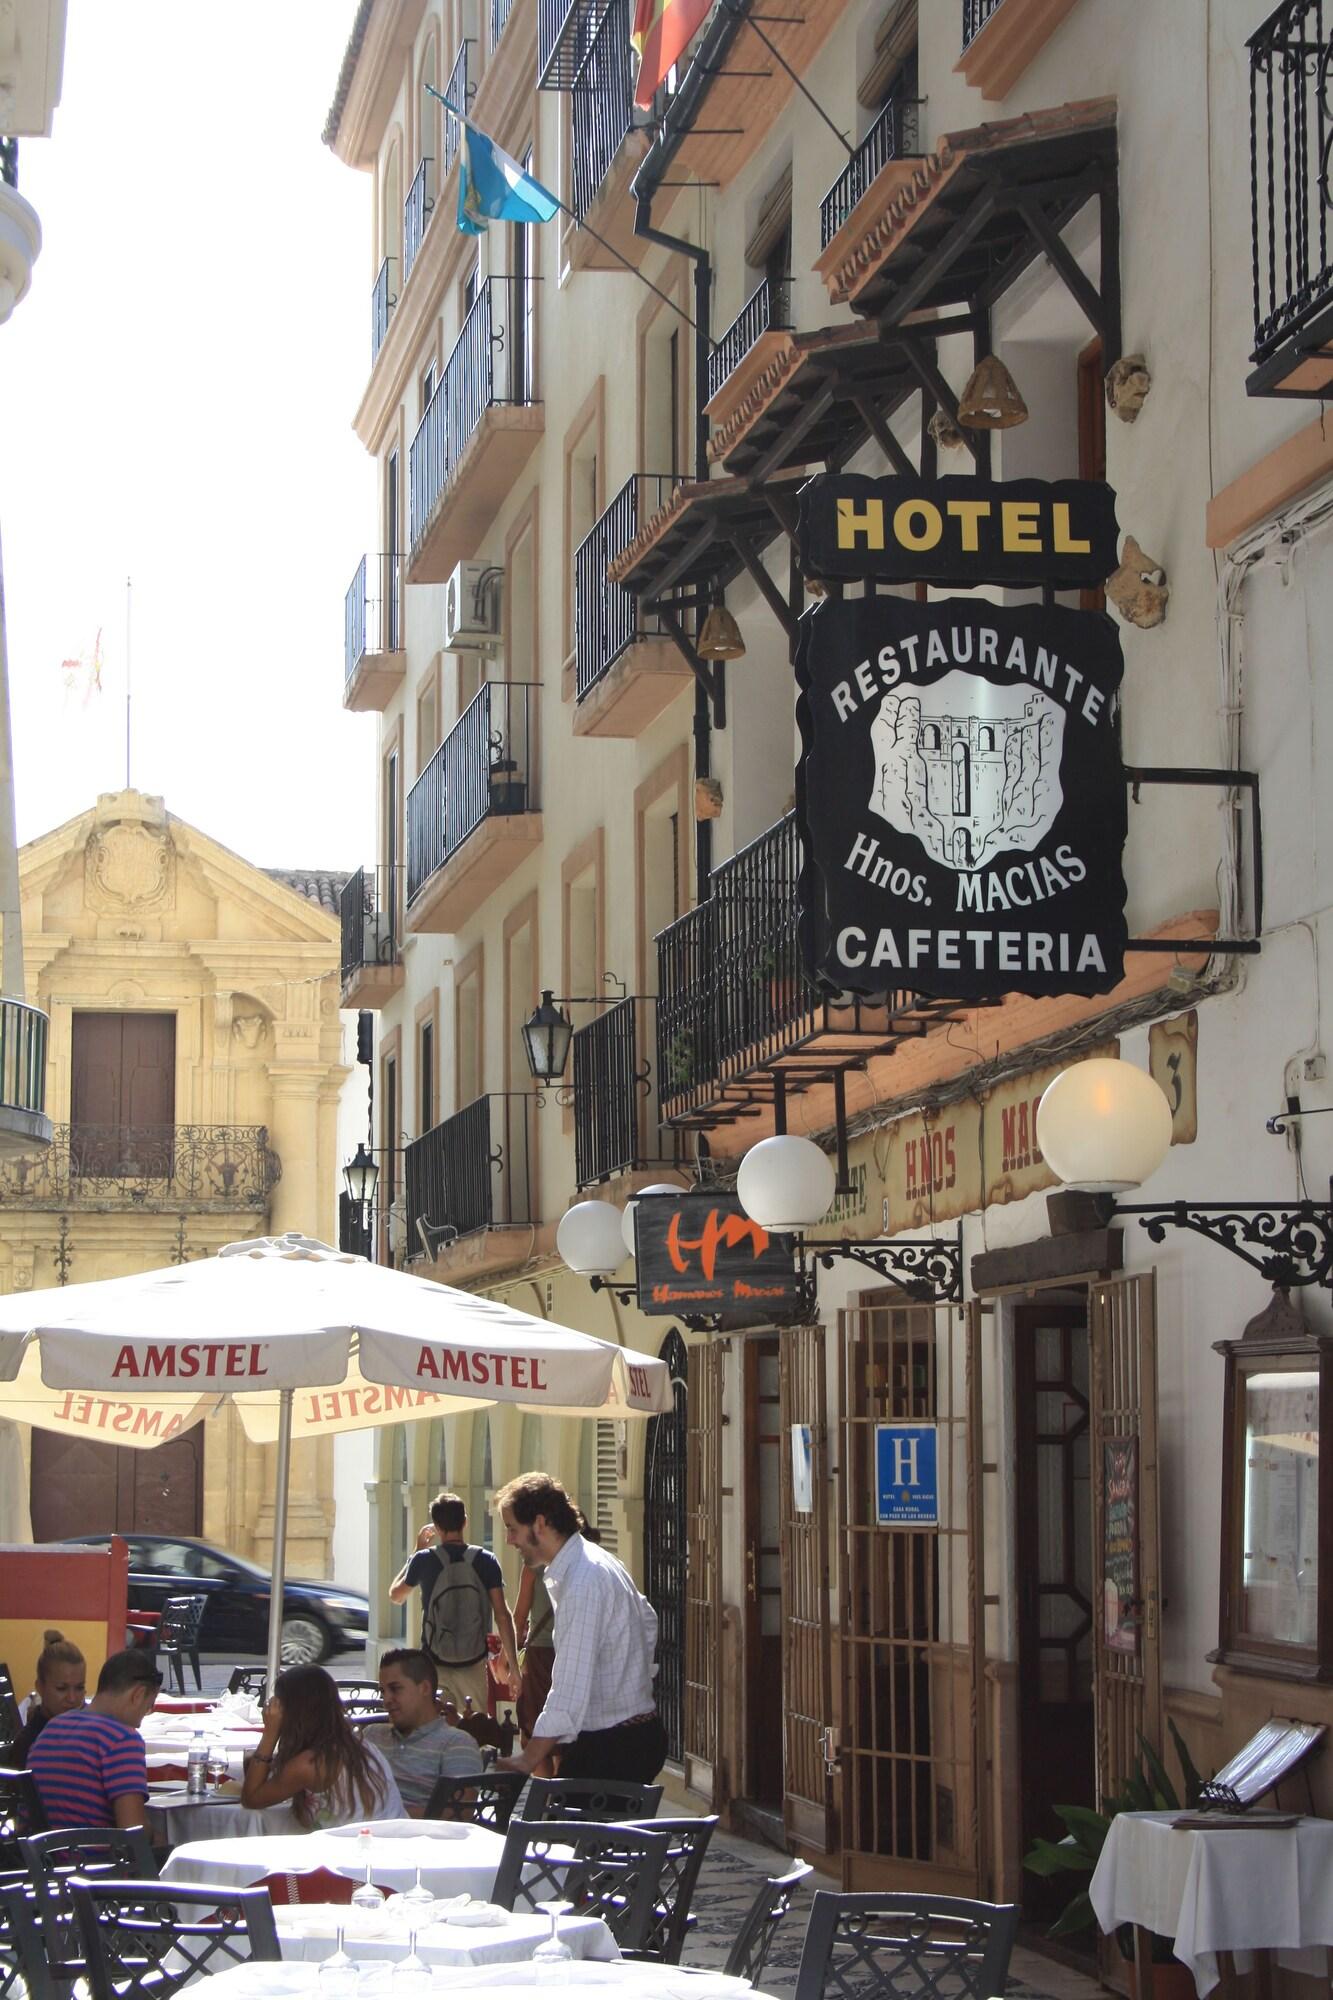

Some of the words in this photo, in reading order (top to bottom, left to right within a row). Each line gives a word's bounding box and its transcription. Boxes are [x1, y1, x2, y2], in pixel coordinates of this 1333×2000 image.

[836, 498, 1091, 554] HOTEL
[829, 626, 1106, 728] RESTAURANTE
[842, 832, 933, 908] Hnos.
[954, 844, 1087, 914] MACIAS
[835, 925, 1108, 974] CAFETERIA
[1001, 1096, 1045, 1174] MAC
[111, 1344, 268, 1378] AMSTEL
[416, 1346, 548, 1391] AMSTEL
[628, 1366, 652, 1398] STEL
[891, 1437, 921, 1487] H
